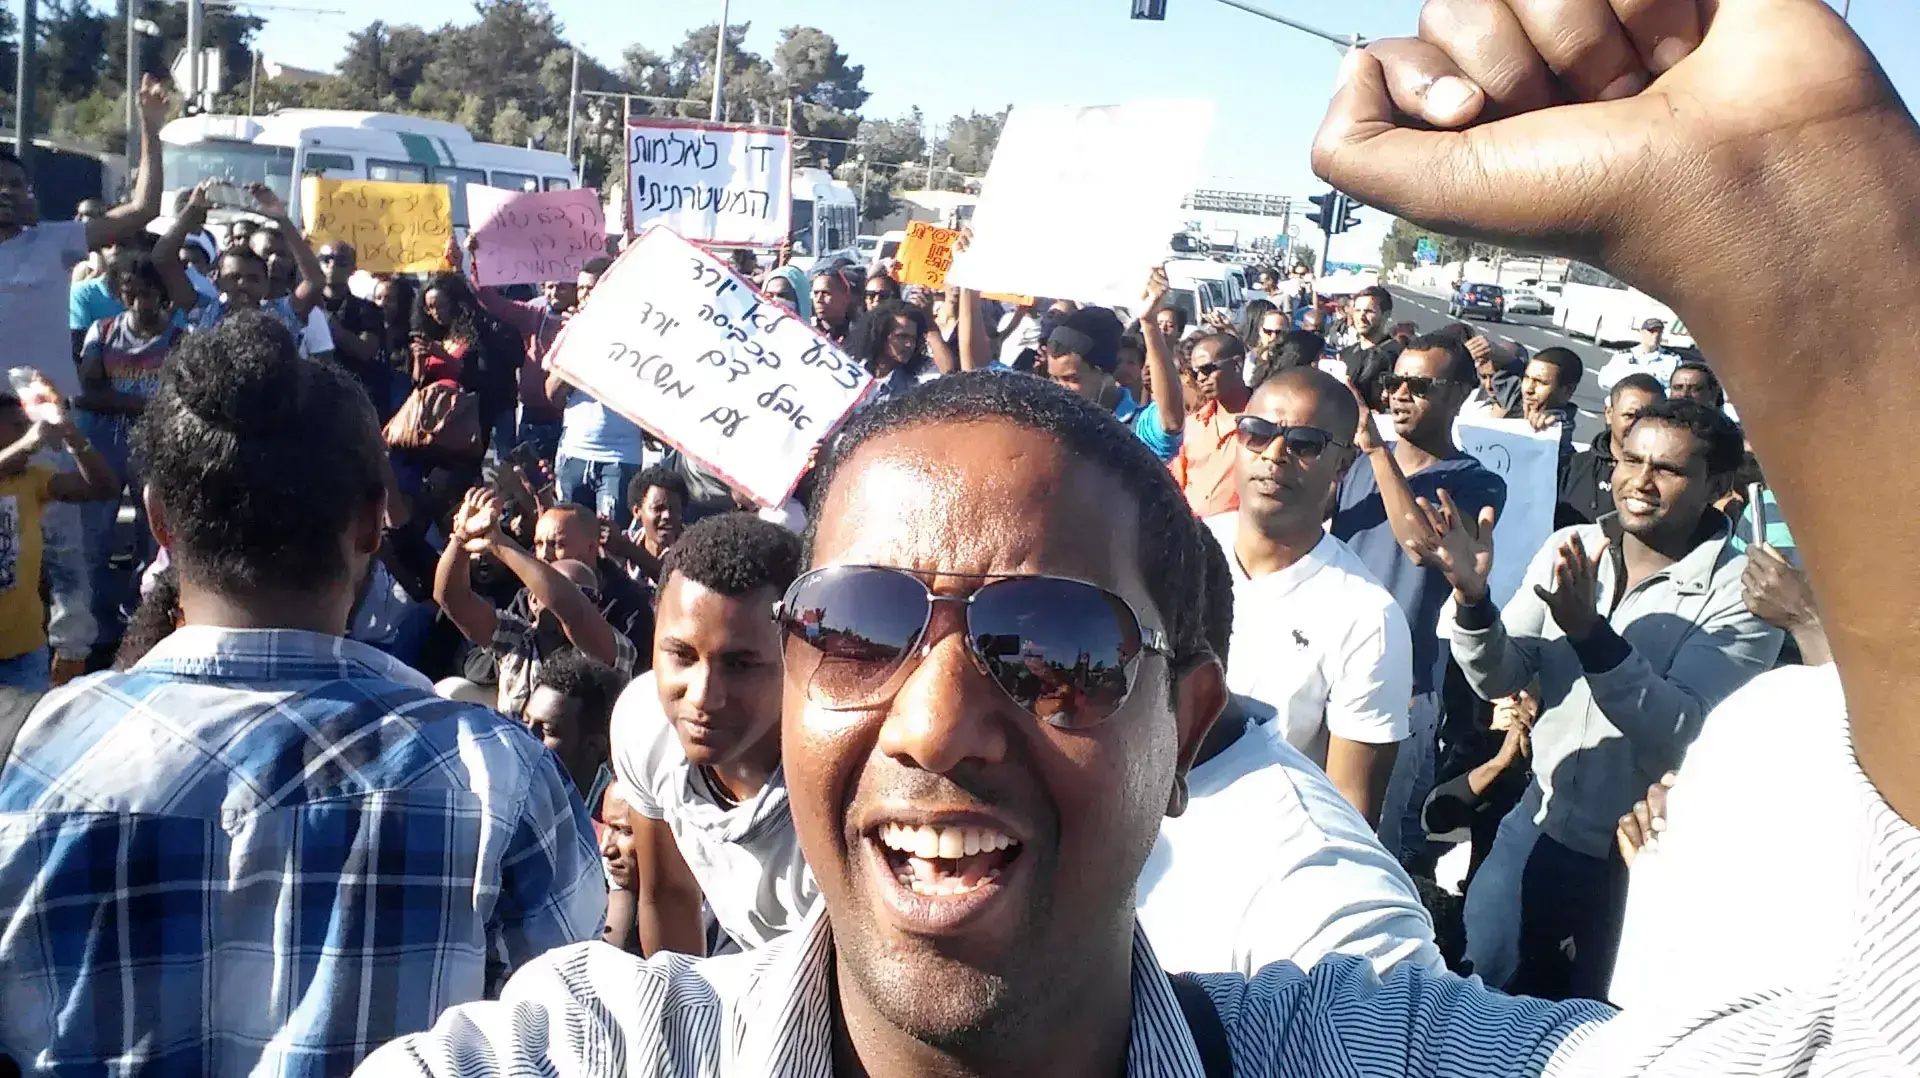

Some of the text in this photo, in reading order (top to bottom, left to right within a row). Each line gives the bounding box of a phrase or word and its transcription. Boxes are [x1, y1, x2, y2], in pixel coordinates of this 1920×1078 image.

[630, 132, 774, 172] די לאלימות
[638, 174, 770, 219] המשטרתית!
[690, 257, 865, 390] צבע לא יורד
[697, 304, 782, 370] בכביסה
[607, 342, 750, 438] עם משטרה
[639, 301, 814, 431] אבל דם יורד
